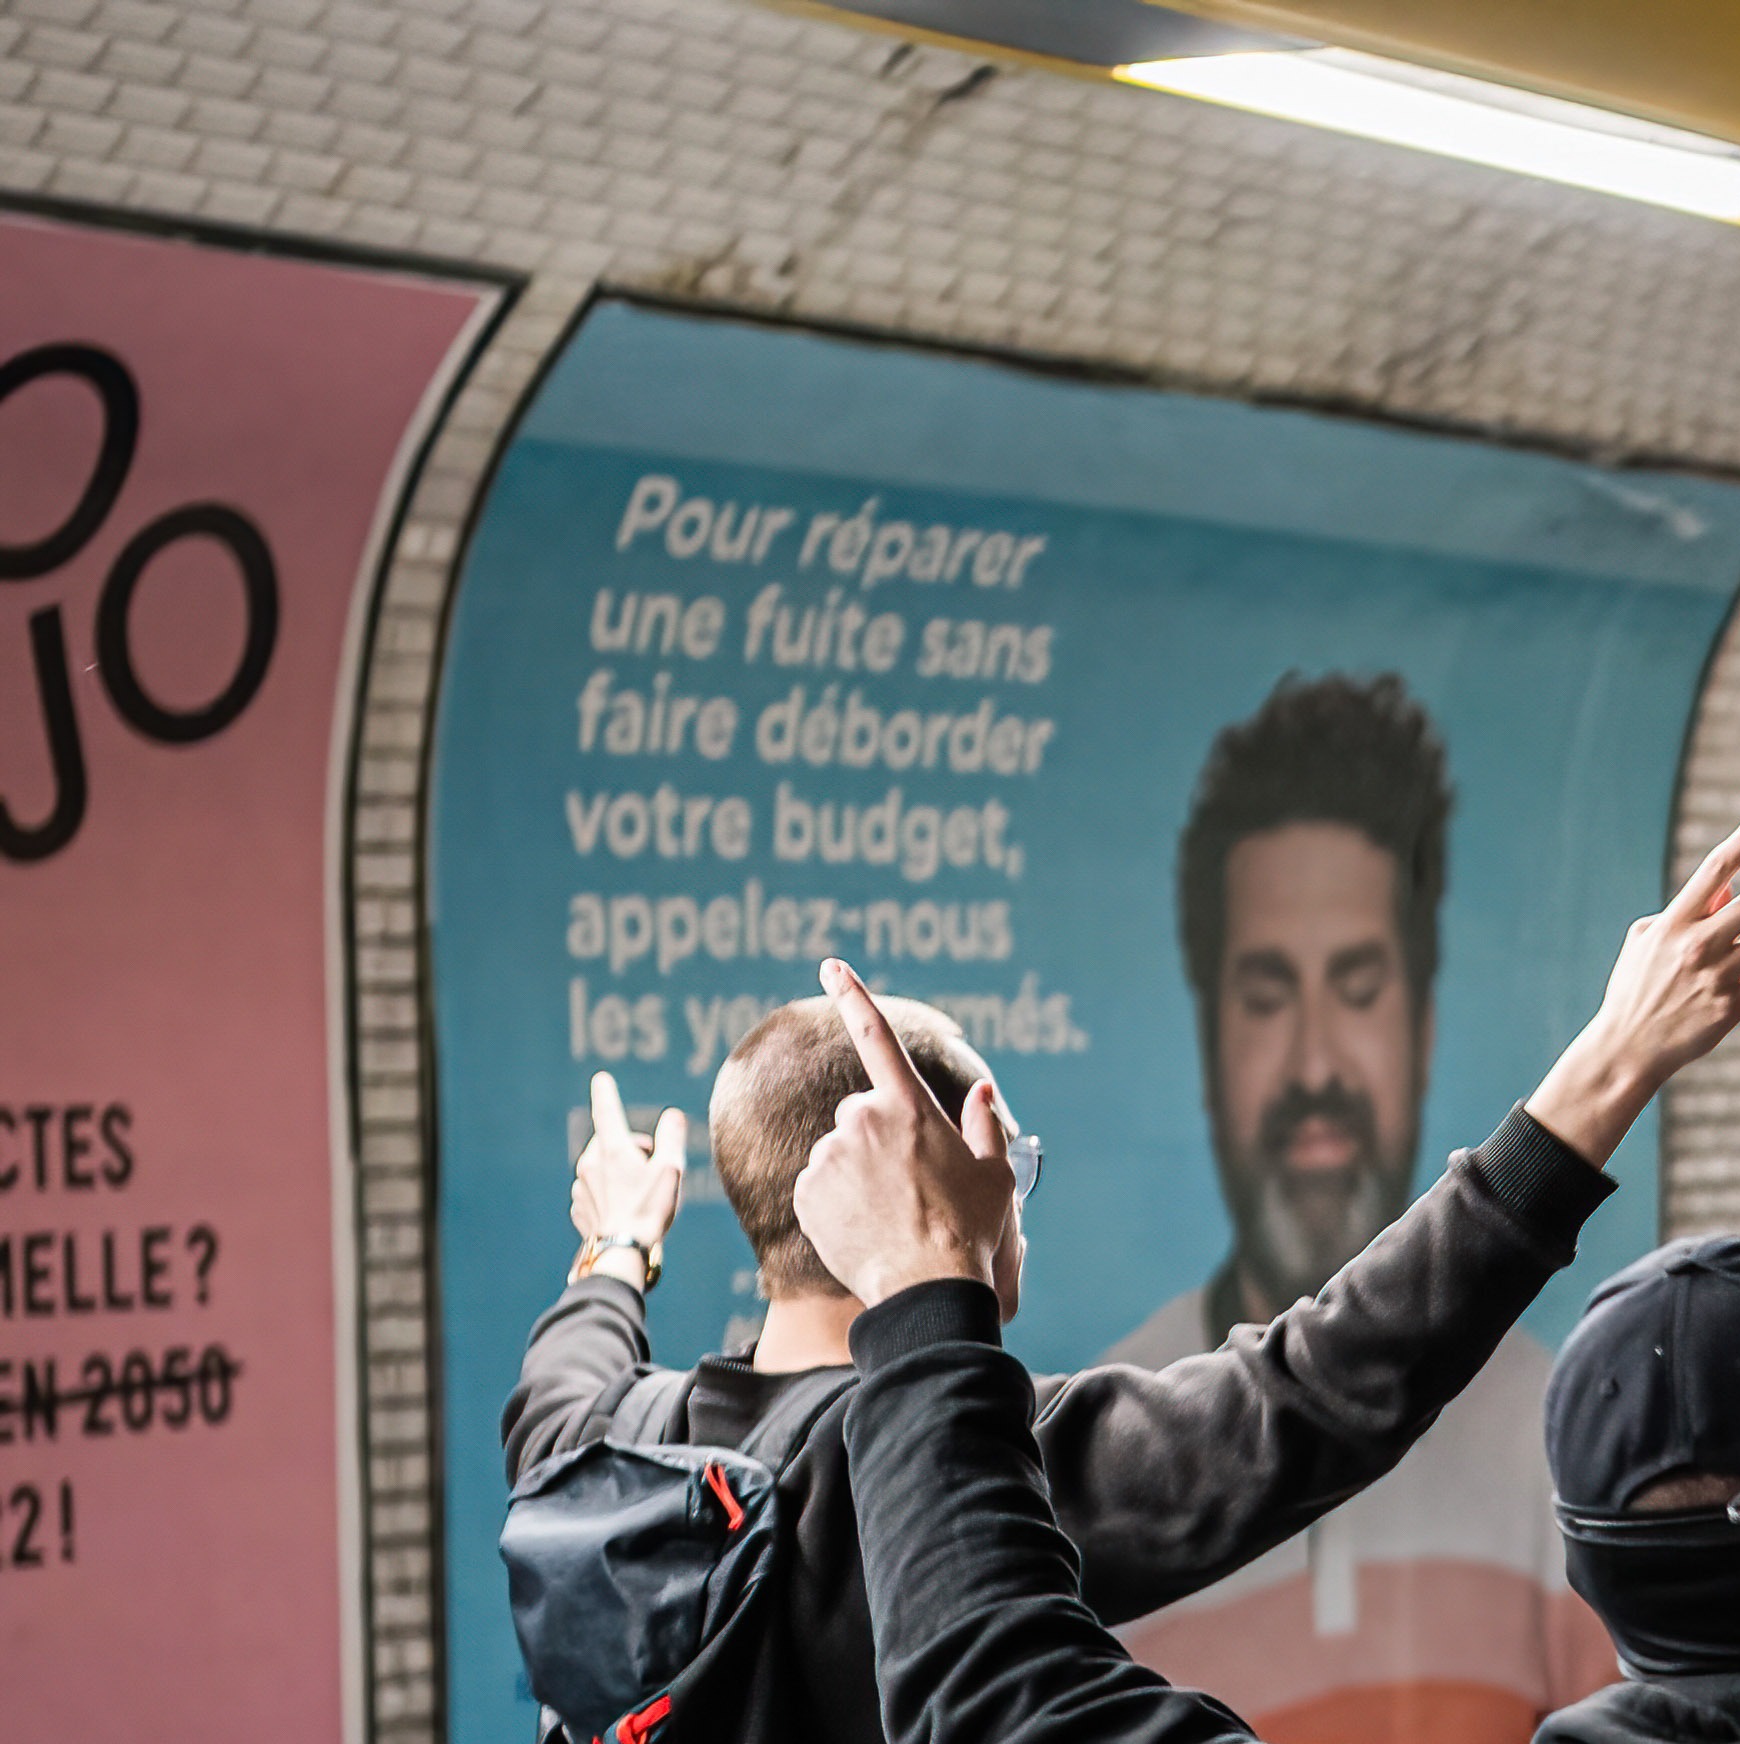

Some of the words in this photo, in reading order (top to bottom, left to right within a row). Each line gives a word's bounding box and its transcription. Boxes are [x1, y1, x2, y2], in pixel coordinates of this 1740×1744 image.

[616, 475, 795, 566] Pour
[799, 496, 1047, 592] réparer
[589, 587, 725, 660] une
[744, 583, 906, 675] fuite
[917, 616, 1055, 684] sans
[578, 667, 739, 761] faire
[755, 684, 1055, 776] déborder
[566, 784, 752, 859] votre
[774, 781, 1024, 882] budget,
[567, 877, 1013, 976] appelez-nous
[569, 977, 665, 1061] les
[82, 1343, 236, 1436] 2050
